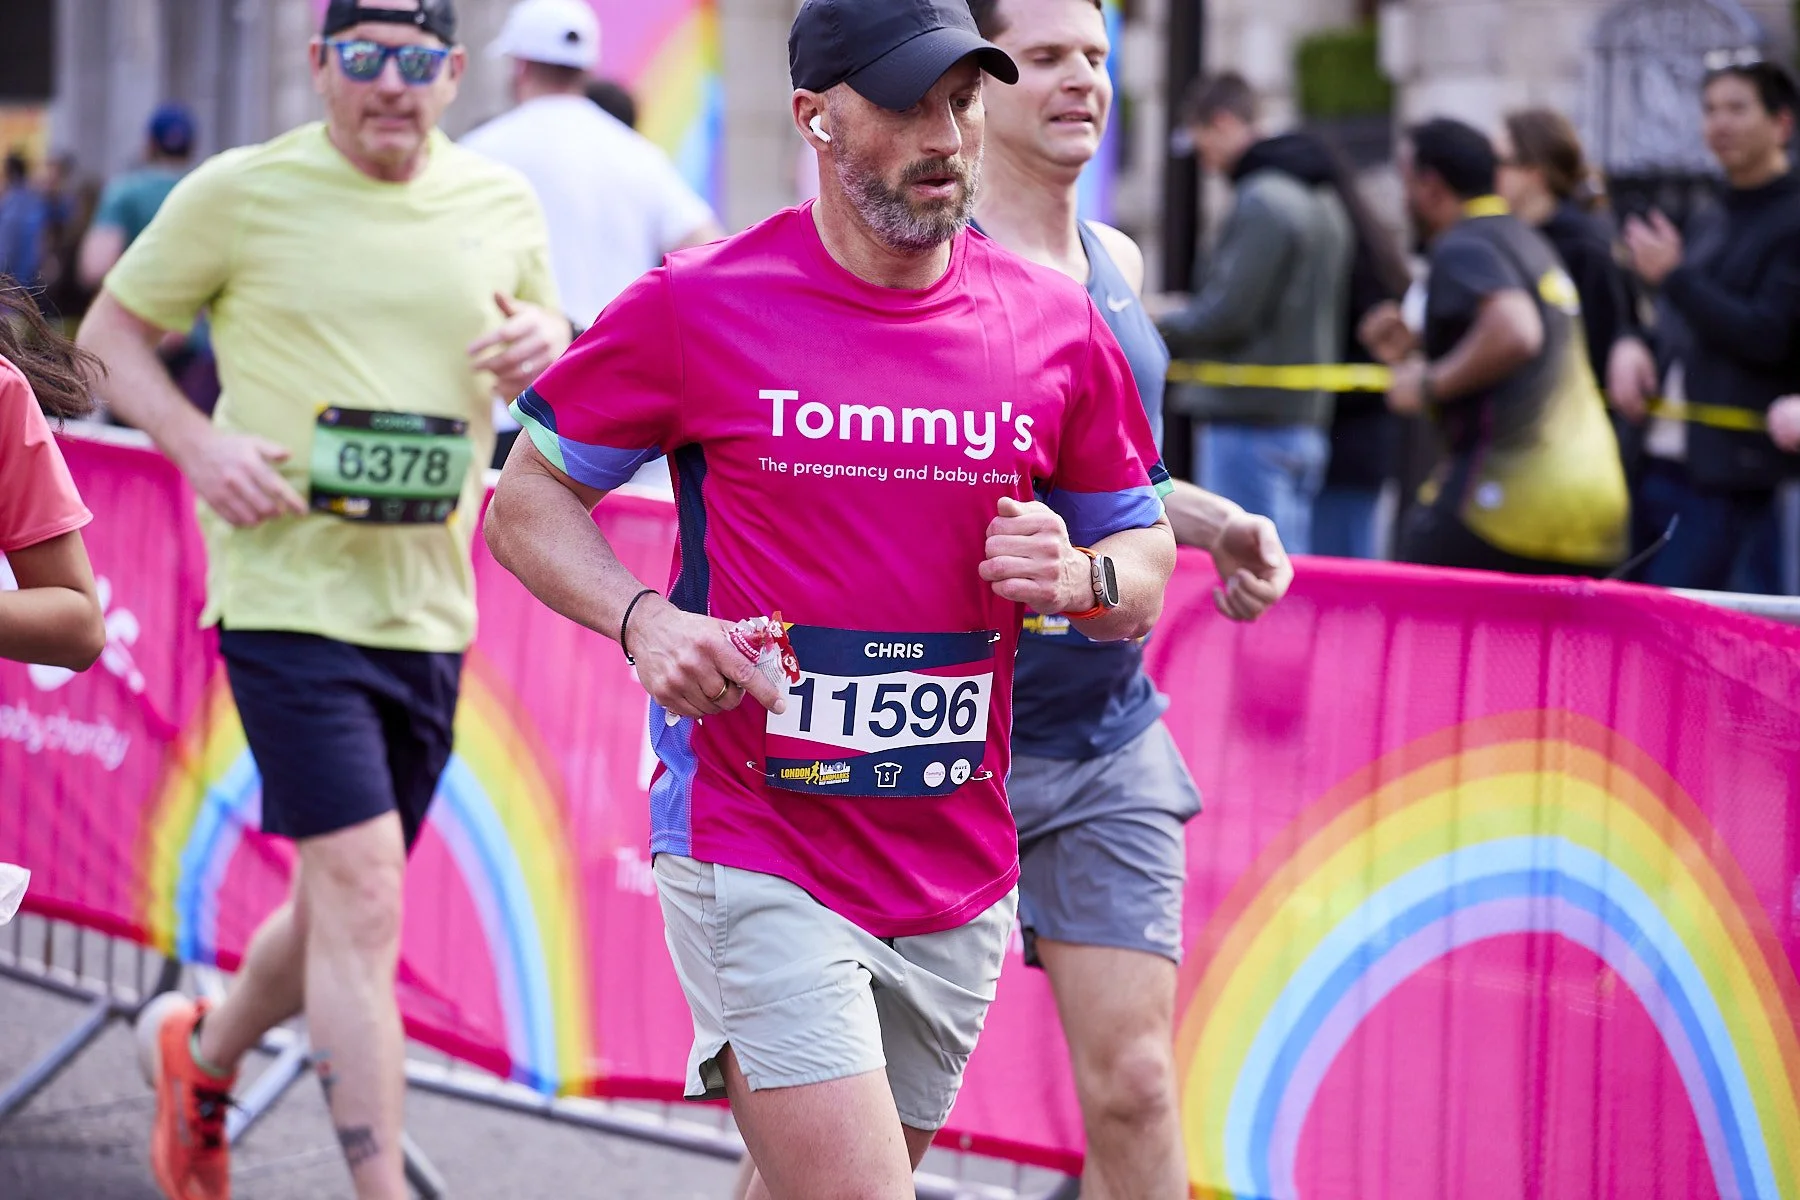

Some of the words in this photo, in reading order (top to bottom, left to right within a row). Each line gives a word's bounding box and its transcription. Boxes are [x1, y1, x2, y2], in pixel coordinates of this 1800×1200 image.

[759, 389, 1034, 460] Tommy's
[338, 440, 450, 487] 6378
[758, 457, 787, 472] The
[793, 462, 888, 481] pregnancy
[893, 465, 928, 480] and
[933, 466, 977, 486] baby
[864, 642, 924, 659] CHRIS
[789, 677, 980, 738] 11596
[780, 767, 811, 779] LONDON
[819, 773, 850, 783] LANDMARKS
[884, 771, 890, 782] S
[956, 771, 964, 780] 4
